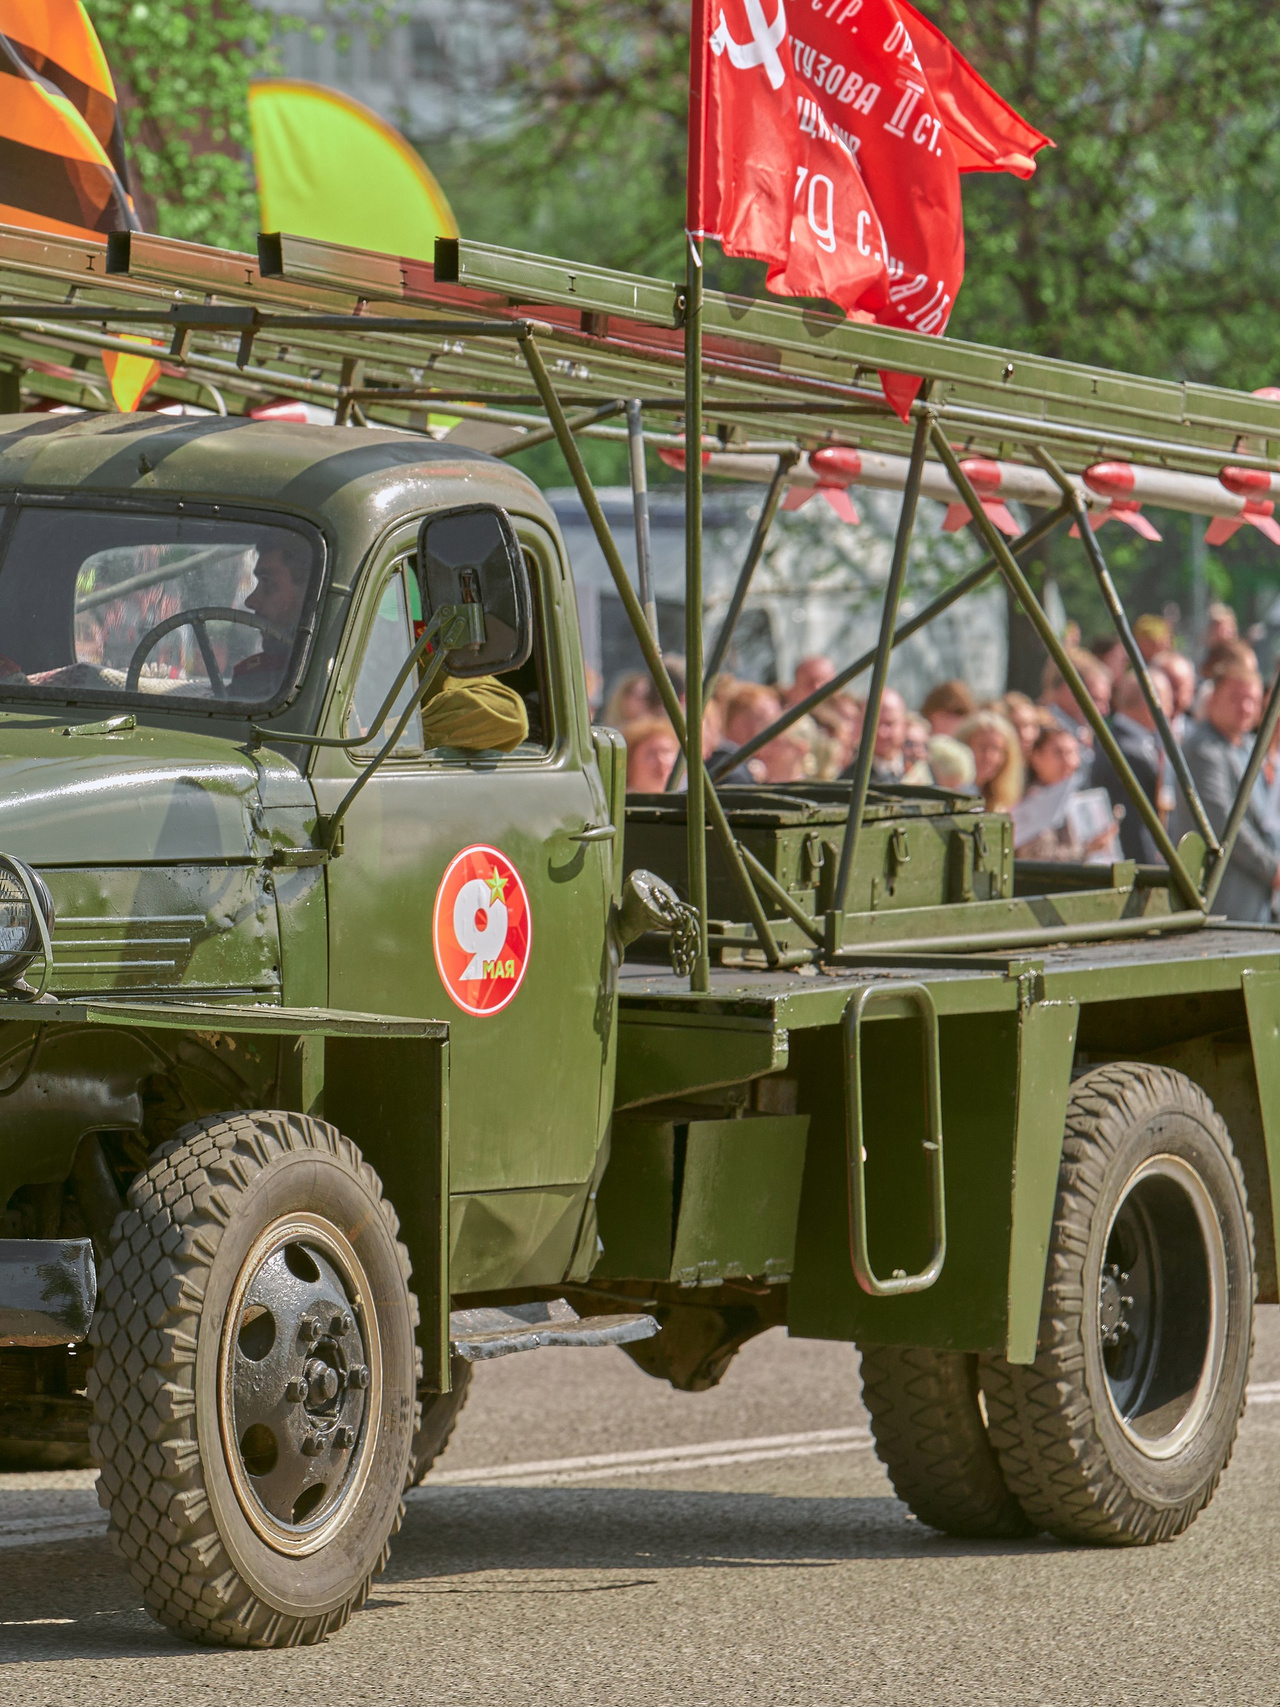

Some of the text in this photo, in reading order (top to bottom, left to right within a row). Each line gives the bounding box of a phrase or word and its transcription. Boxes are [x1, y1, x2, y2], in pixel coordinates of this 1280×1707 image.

[789, 35, 882, 116] ТУЗОВА
[452, 878, 509, 981] 9
[482, 959, 516, 980] МАЯ
